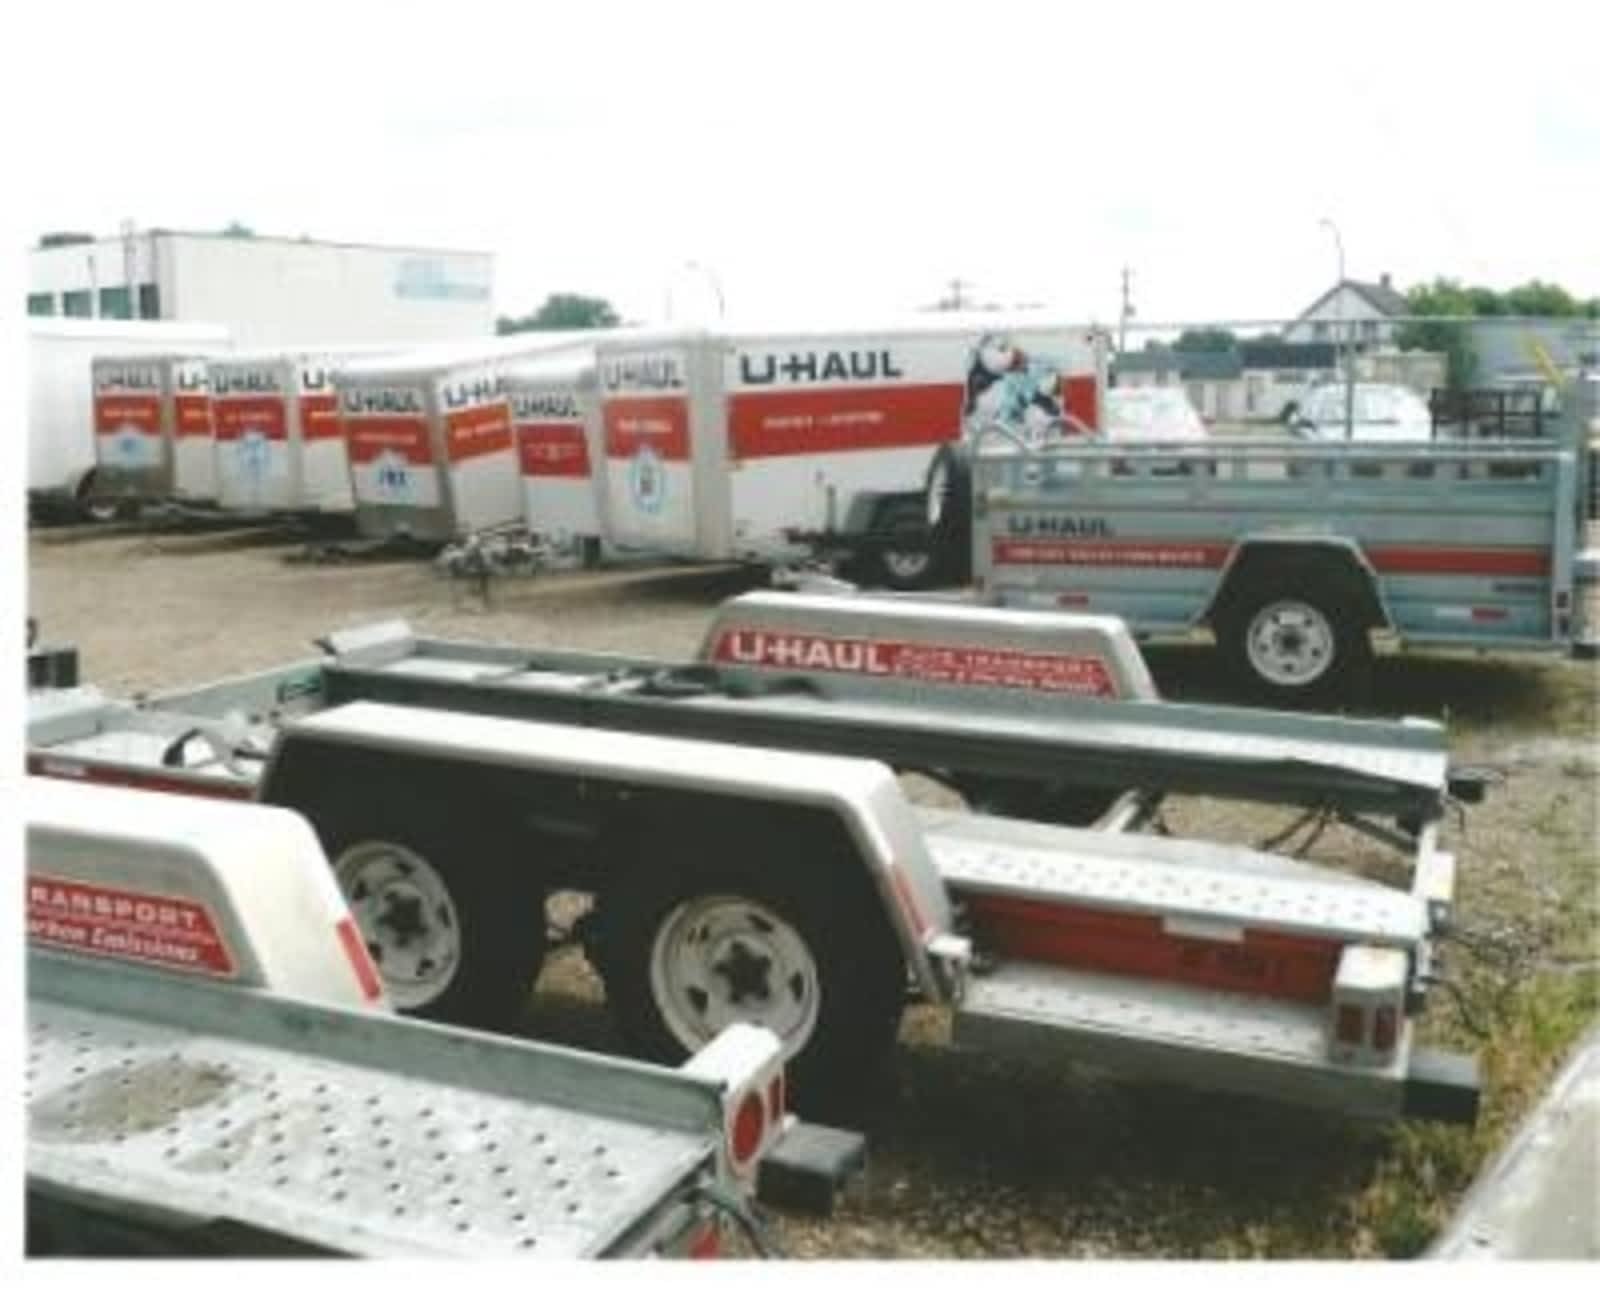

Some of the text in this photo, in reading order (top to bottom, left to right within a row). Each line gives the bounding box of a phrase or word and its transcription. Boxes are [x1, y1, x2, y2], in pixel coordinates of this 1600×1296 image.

[741, 349, 904, 385] U-HAUL
[1007, 514, 1115, 537] U-HAUL
[731, 633, 890, 674] U-HAUL
